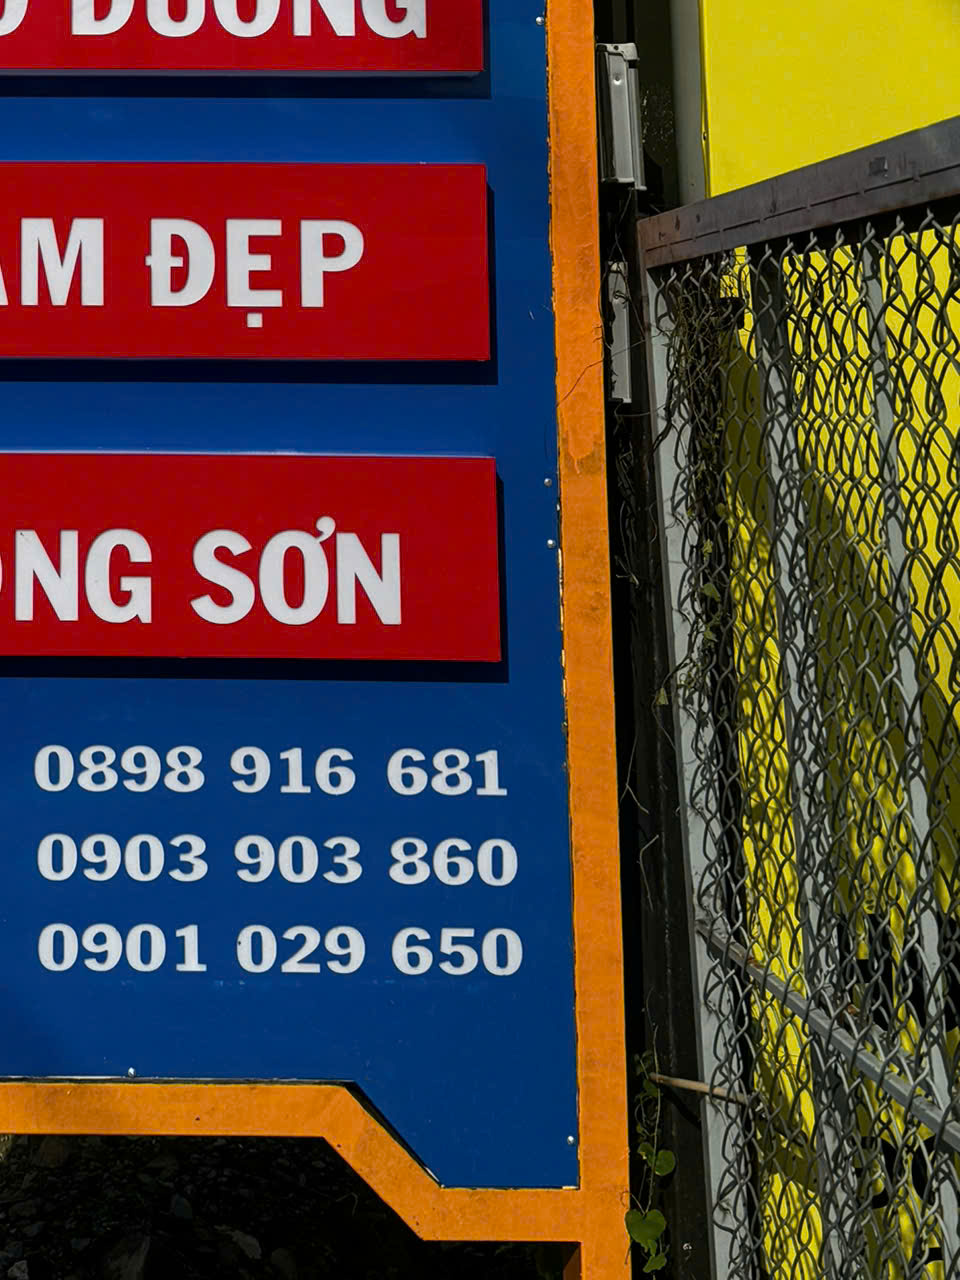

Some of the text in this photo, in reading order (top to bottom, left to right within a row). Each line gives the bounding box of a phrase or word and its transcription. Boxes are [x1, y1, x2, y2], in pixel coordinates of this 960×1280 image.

[145, 218, 364, 328] ĐẸP
[190, 516, 402, 626] SƠN
[34, 744, 508, 796] 0898 916 681
[37, 833, 518, 887] 0903 903 860
[38, 923, 523, 976] 0901 029 650
